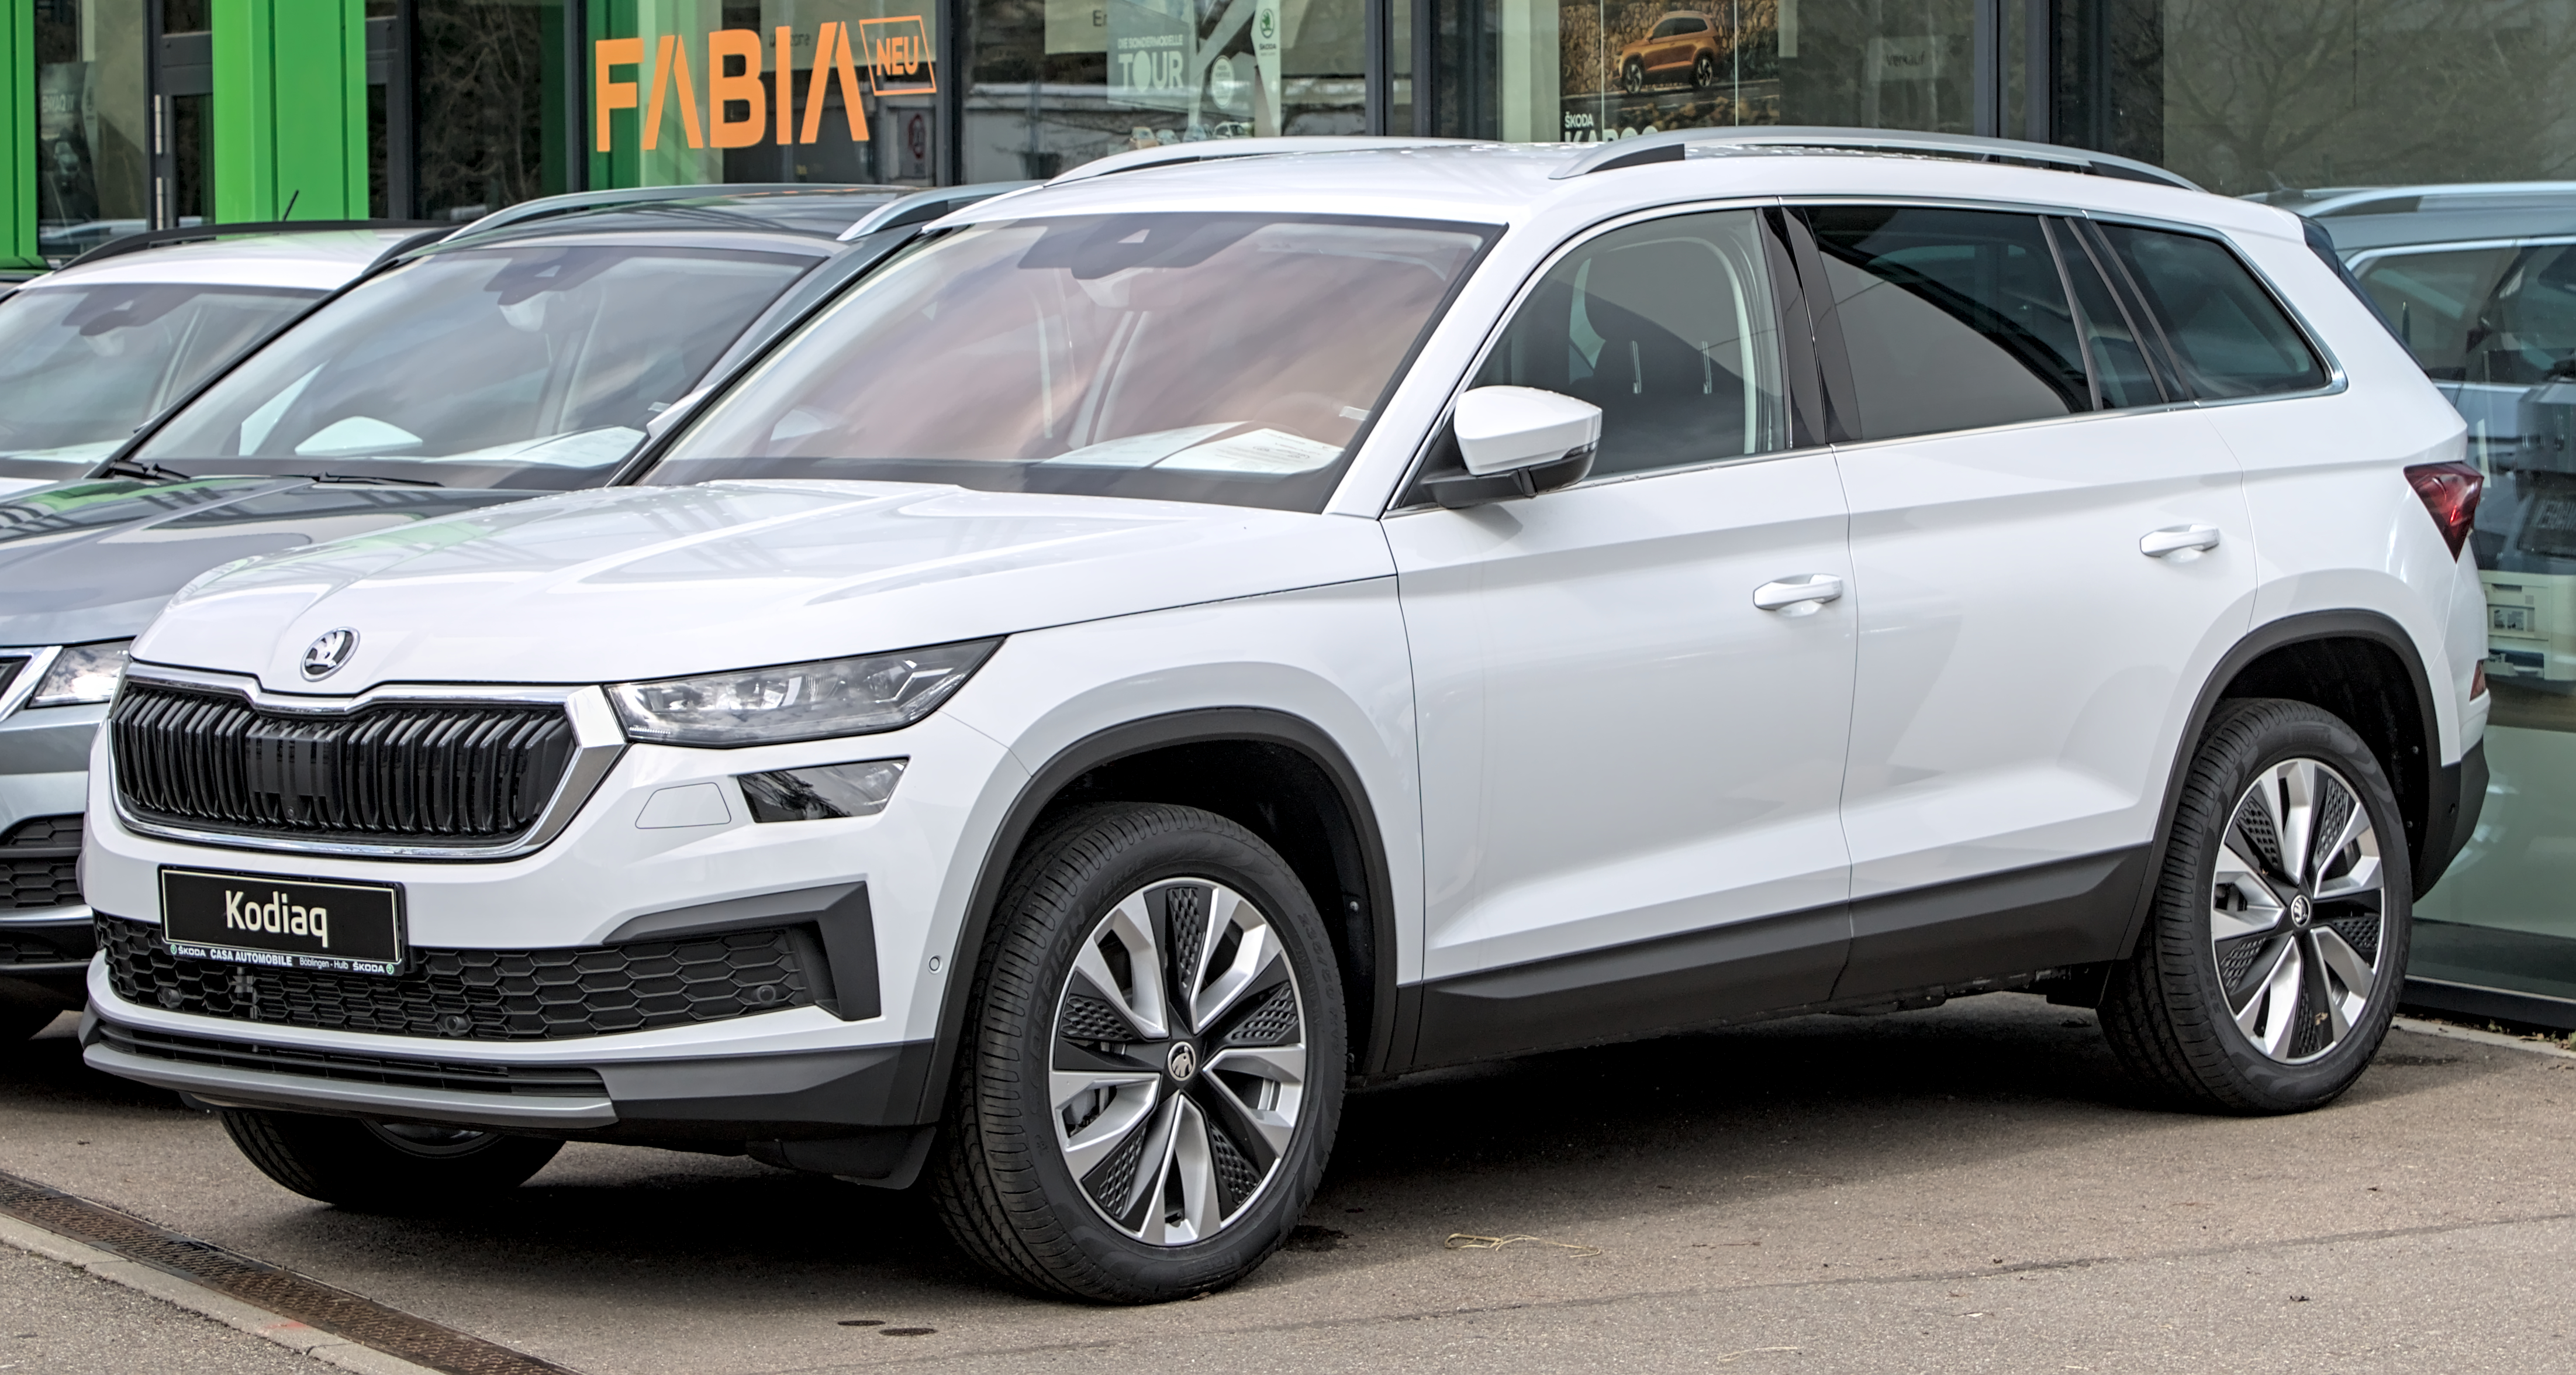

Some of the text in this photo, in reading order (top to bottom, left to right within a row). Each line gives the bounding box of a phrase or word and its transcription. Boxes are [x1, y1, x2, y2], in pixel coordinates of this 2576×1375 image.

[876, 36, 918, 76] NEU
[1118, 34, 1183, 49] DIE SONDERMODELLE
[596, 21, 869, 152] FABIA
[1118, 50, 1183, 92] TOUR
[1565, 111, 1594, 128] ŠKODA
[225, 890, 329, 949] Kodiaq
[178, 945, 206, 957] ŠKODA
[210, 948, 233, 961] CASA
[235, 951, 292, 967] AUTOMOBILE
[299, 957, 329, 969] Böblingen
[334, 960, 348, 970] Hulb
[353, 961, 385, 973] ŠKODA
